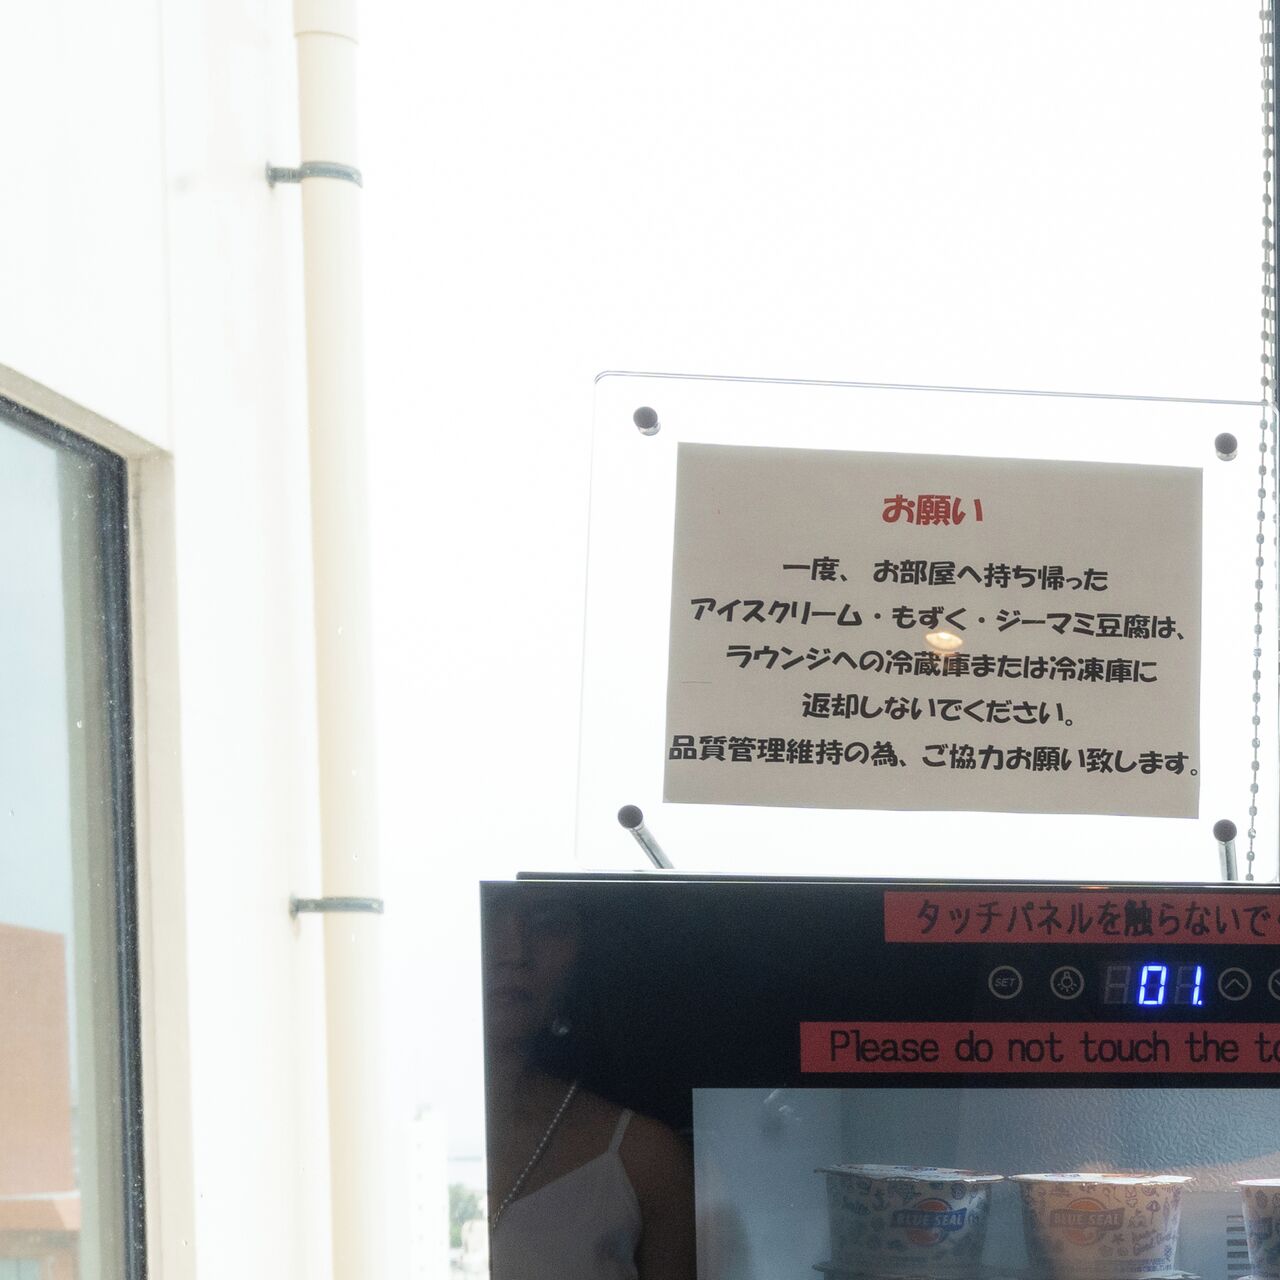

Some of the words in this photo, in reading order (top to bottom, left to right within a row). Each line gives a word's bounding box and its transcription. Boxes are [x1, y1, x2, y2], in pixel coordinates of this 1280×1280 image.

[882, 494, 983, 526] お願い
[726, 644, 1158, 683] ラウンジへの冷蔵庫または冷凍庫に
[802, 692, 1074, 726] 返却しないでください。
[668, 734, 1200, 777] 品質管理維持の為、ご協力お願い致します。
[994, 977, 1016, 988] SET
[830, 1031, 940, 1064] Please
[955, 1032, 993, 1064] do
[1007, 1035, 1064, 1064] not
[1080, 1031, 1169, 1064] touch
[1185, 1031, 1239, 1064] the
[935, 1212, 963, 1226] SEAL
